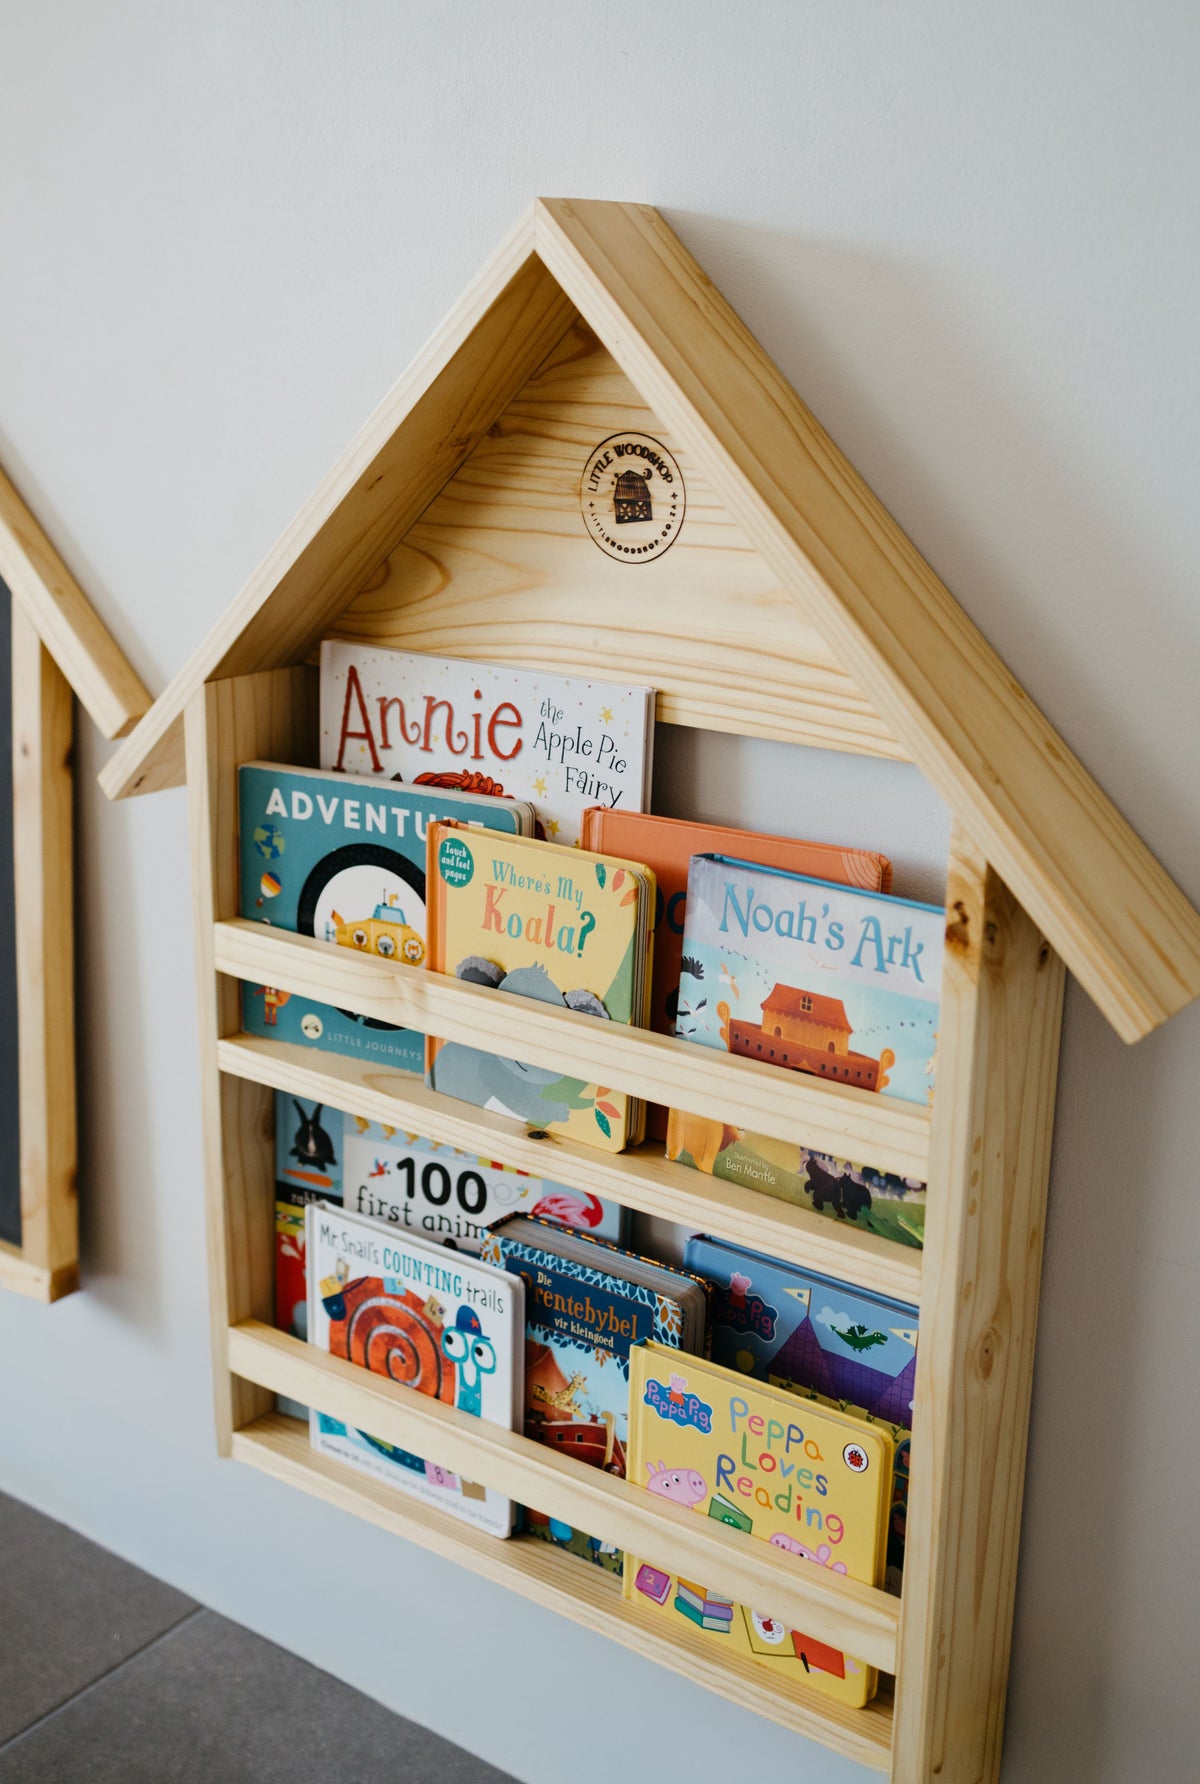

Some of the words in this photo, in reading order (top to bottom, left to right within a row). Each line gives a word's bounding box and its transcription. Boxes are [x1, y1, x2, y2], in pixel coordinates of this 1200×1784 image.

[588, 451, 614, 492] LITTLE
[613, 443, 674, 484] WOODSHOP
[332, 664, 523, 772] Annie
[540, 698, 564, 725] the
[532, 722, 593, 764] Apple
[596, 734, 627, 774] Pie
[565, 766, 624, 808] Fairy
[265, 788, 484, 842] ADVENTU
[441, 855, 455, 866] and
[456, 857, 470, 870] feel
[445, 841, 467, 858] Touch
[444, 869, 466, 883] pages
[491, 859, 551, 895] Where's
[556, 875, 584, 910] My
[481, 883, 596, 958] Koala?
[719, 881, 845, 950] Noah's
[850, 915, 926, 983] Ark
[327, 1032, 362, 1048] LITTLE
[364, 1041, 422, 1061] JOURNEYS
[396, 1157, 487, 1215] 100
[726, 1157, 742, 1173] Ben
[743, 1164, 776, 1185] Mantle
[357, 1185, 412, 1226] first
[341, 1231, 380, 1265] Snail's
[382, 1247, 463, 1298] COUNTING
[466, 1281, 504, 1314] trails
[537, 1271, 553, 1288] Die
[553, 1317, 569, 1330] vir
[570, 1320, 615, 1349] kleingoed
[750, 1301, 773, 1337] Pig
[647, 1381, 688, 1419] Peppa
[689, 1398, 711, 1431] Pig
[729, 1396, 825, 1462] Peppa
[741, 1431, 829, 1497] Loves
[716, 1453, 845, 1545] Reading
